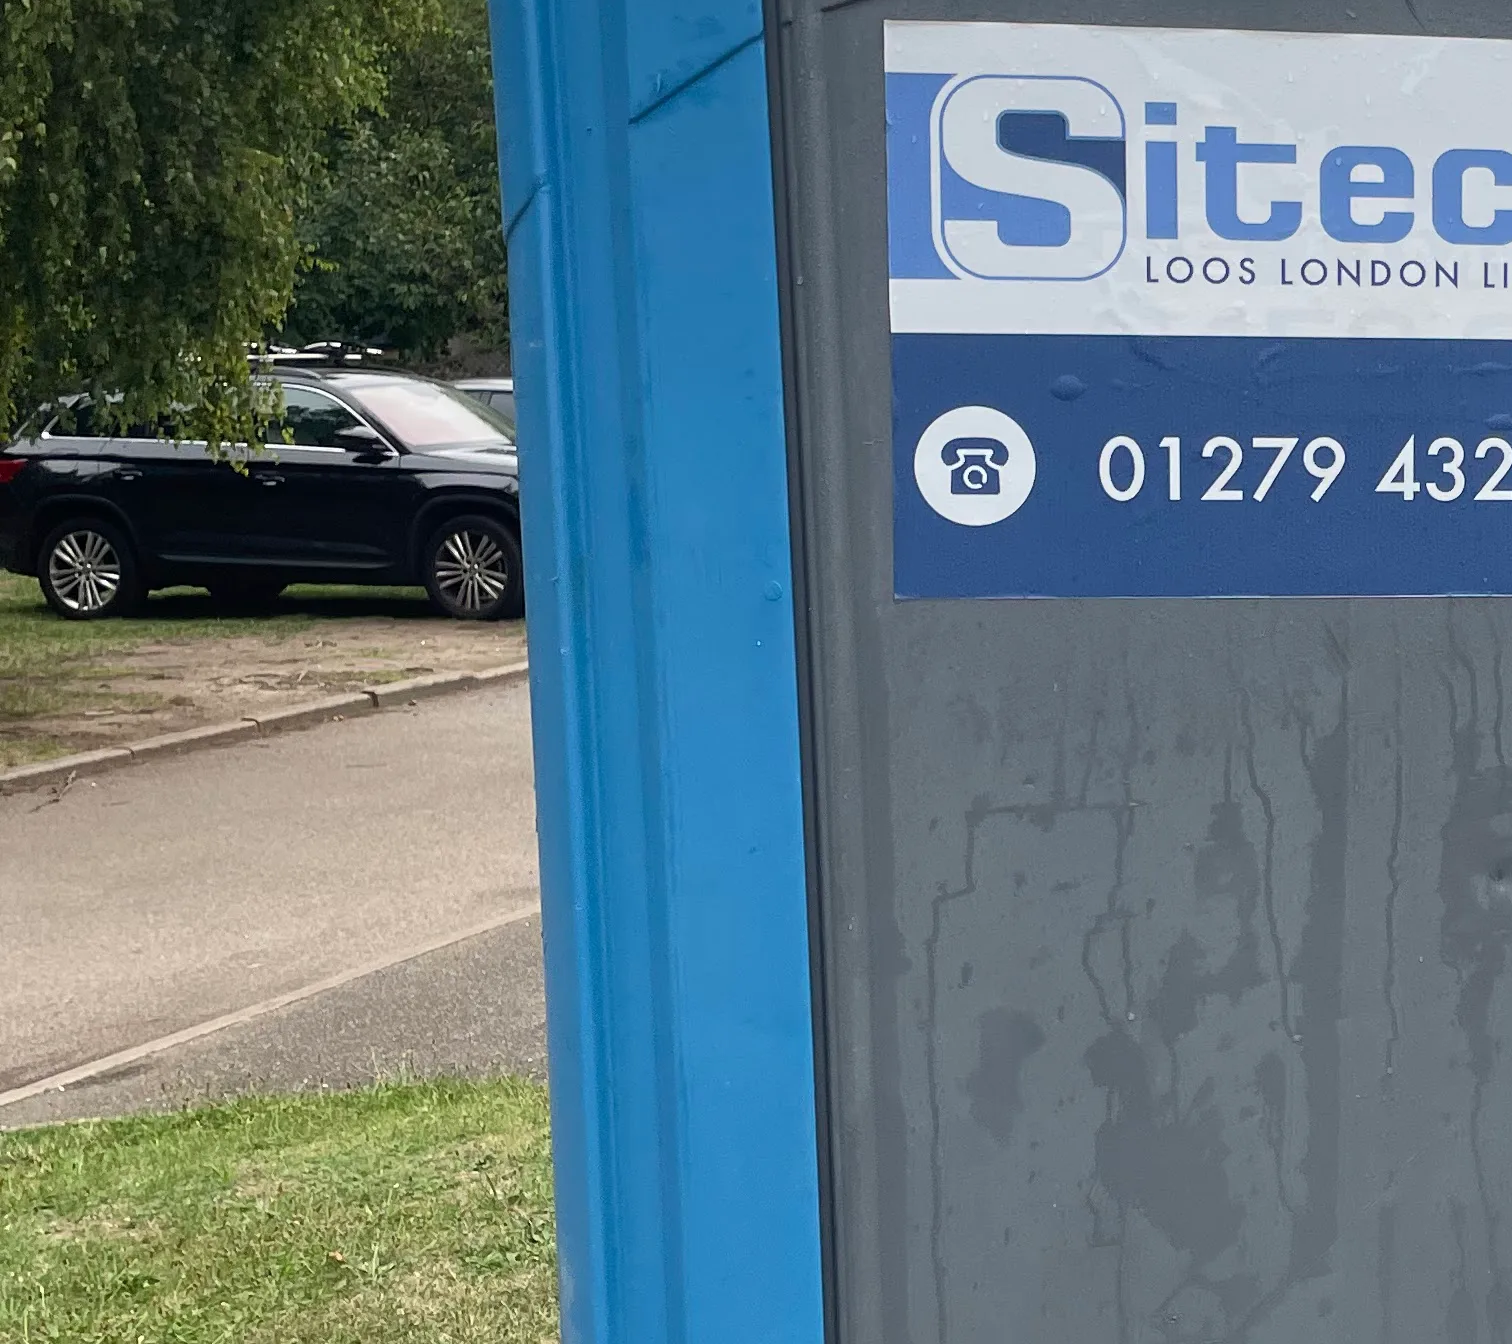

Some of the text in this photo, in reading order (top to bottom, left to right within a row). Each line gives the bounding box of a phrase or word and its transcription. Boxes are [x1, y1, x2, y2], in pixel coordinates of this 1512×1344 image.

[1145, 255, 1257, 285] LOOS
[1280, 257, 1460, 290] LONDON
[1098, 434, 1347, 503] 01279
